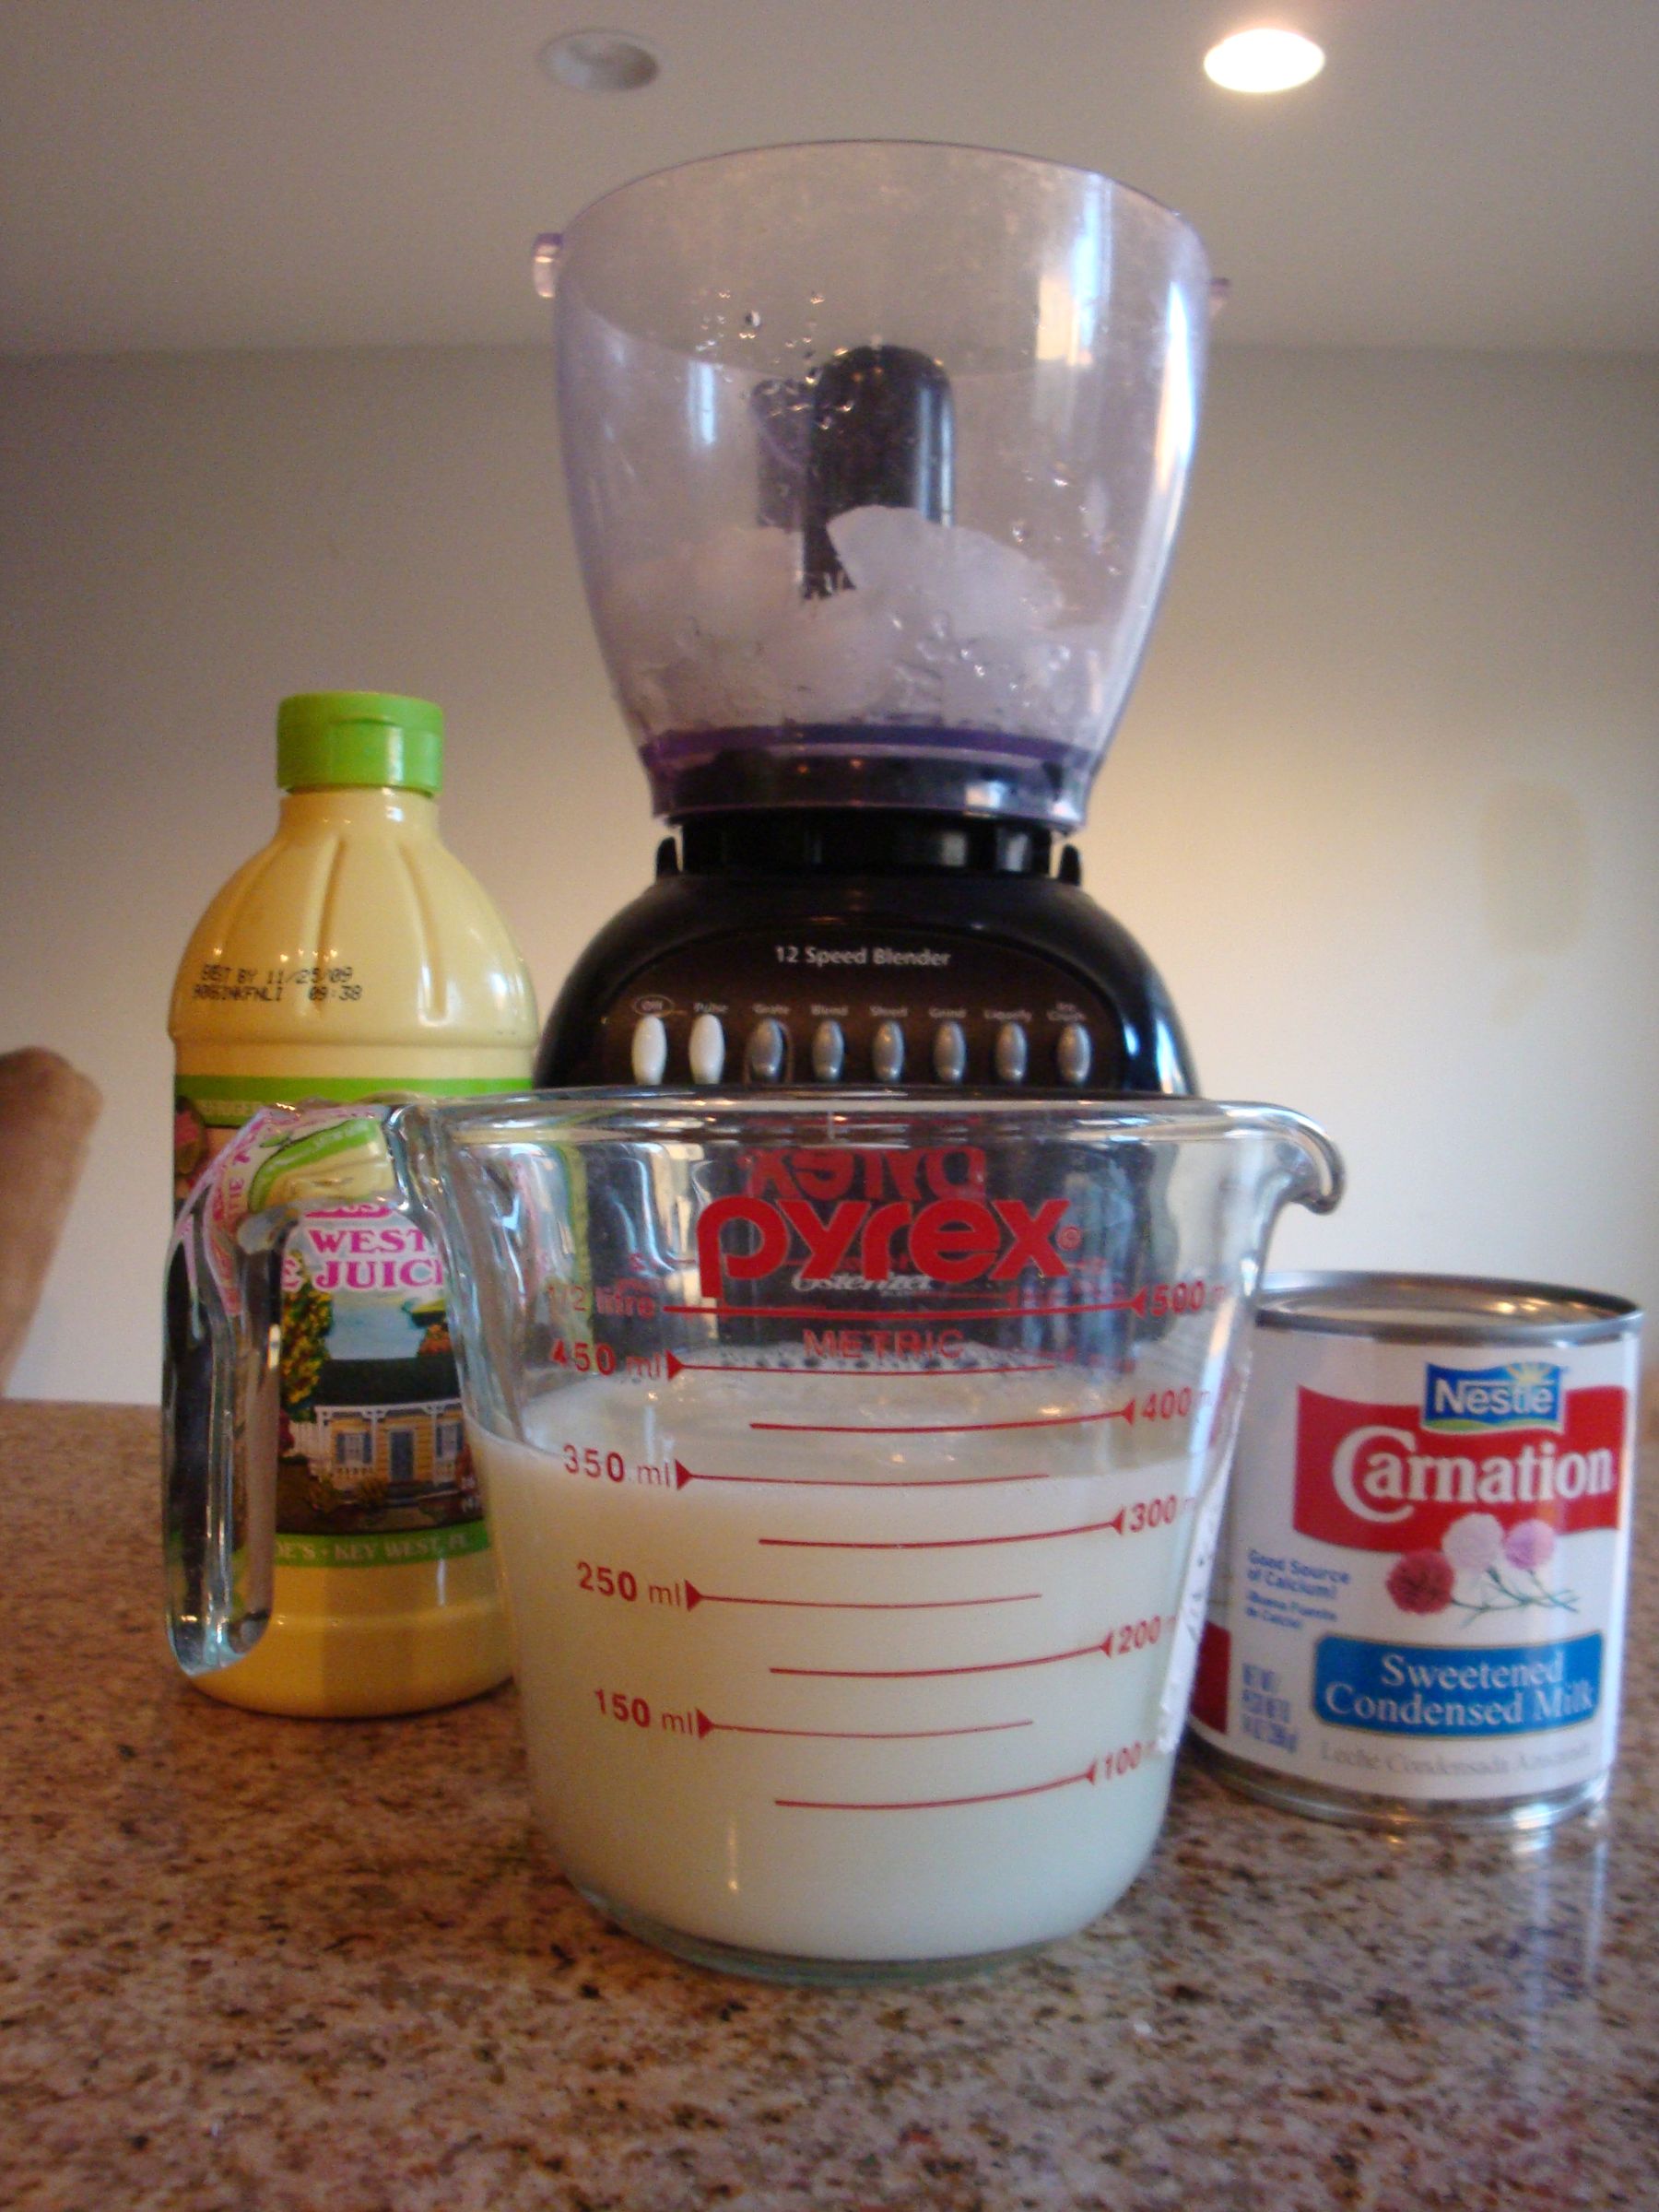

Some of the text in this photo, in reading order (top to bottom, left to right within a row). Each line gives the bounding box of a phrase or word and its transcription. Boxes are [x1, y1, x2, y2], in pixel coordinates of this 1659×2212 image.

[776, 945, 951, 968] 12 Speed Blender
[309, 1229, 426, 1253] WEST
[697, 1196, 1070, 1298] pyrex
[1151, 1279, 1206, 1316] 500
[549, 1338, 661, 1379] 450 ml
[802, 1327, 965, 1359] METRIC
[1141, 1386, 1192, 1421] 400
[563, 1443, 670, 1488] 350 ml
[1331, 1424, 1615, 1524] Carnation
[1130, 1494, 1178, 1533] 300
[383, 1536, 440, 1558] WEST
[577, 1561, 680, 1607] 250 ml
[1117, 1616, 1161, 1654] 200
[1381, 1651, 1563, 1690] Sweetened
[594, 1688, 693, 1736] 150 ml
[1324, 1682, 1524, 1727] Condensed
[1533, 1680, 1594, 1721] Milk
[1104, 1740, 1142, 1780] 100
